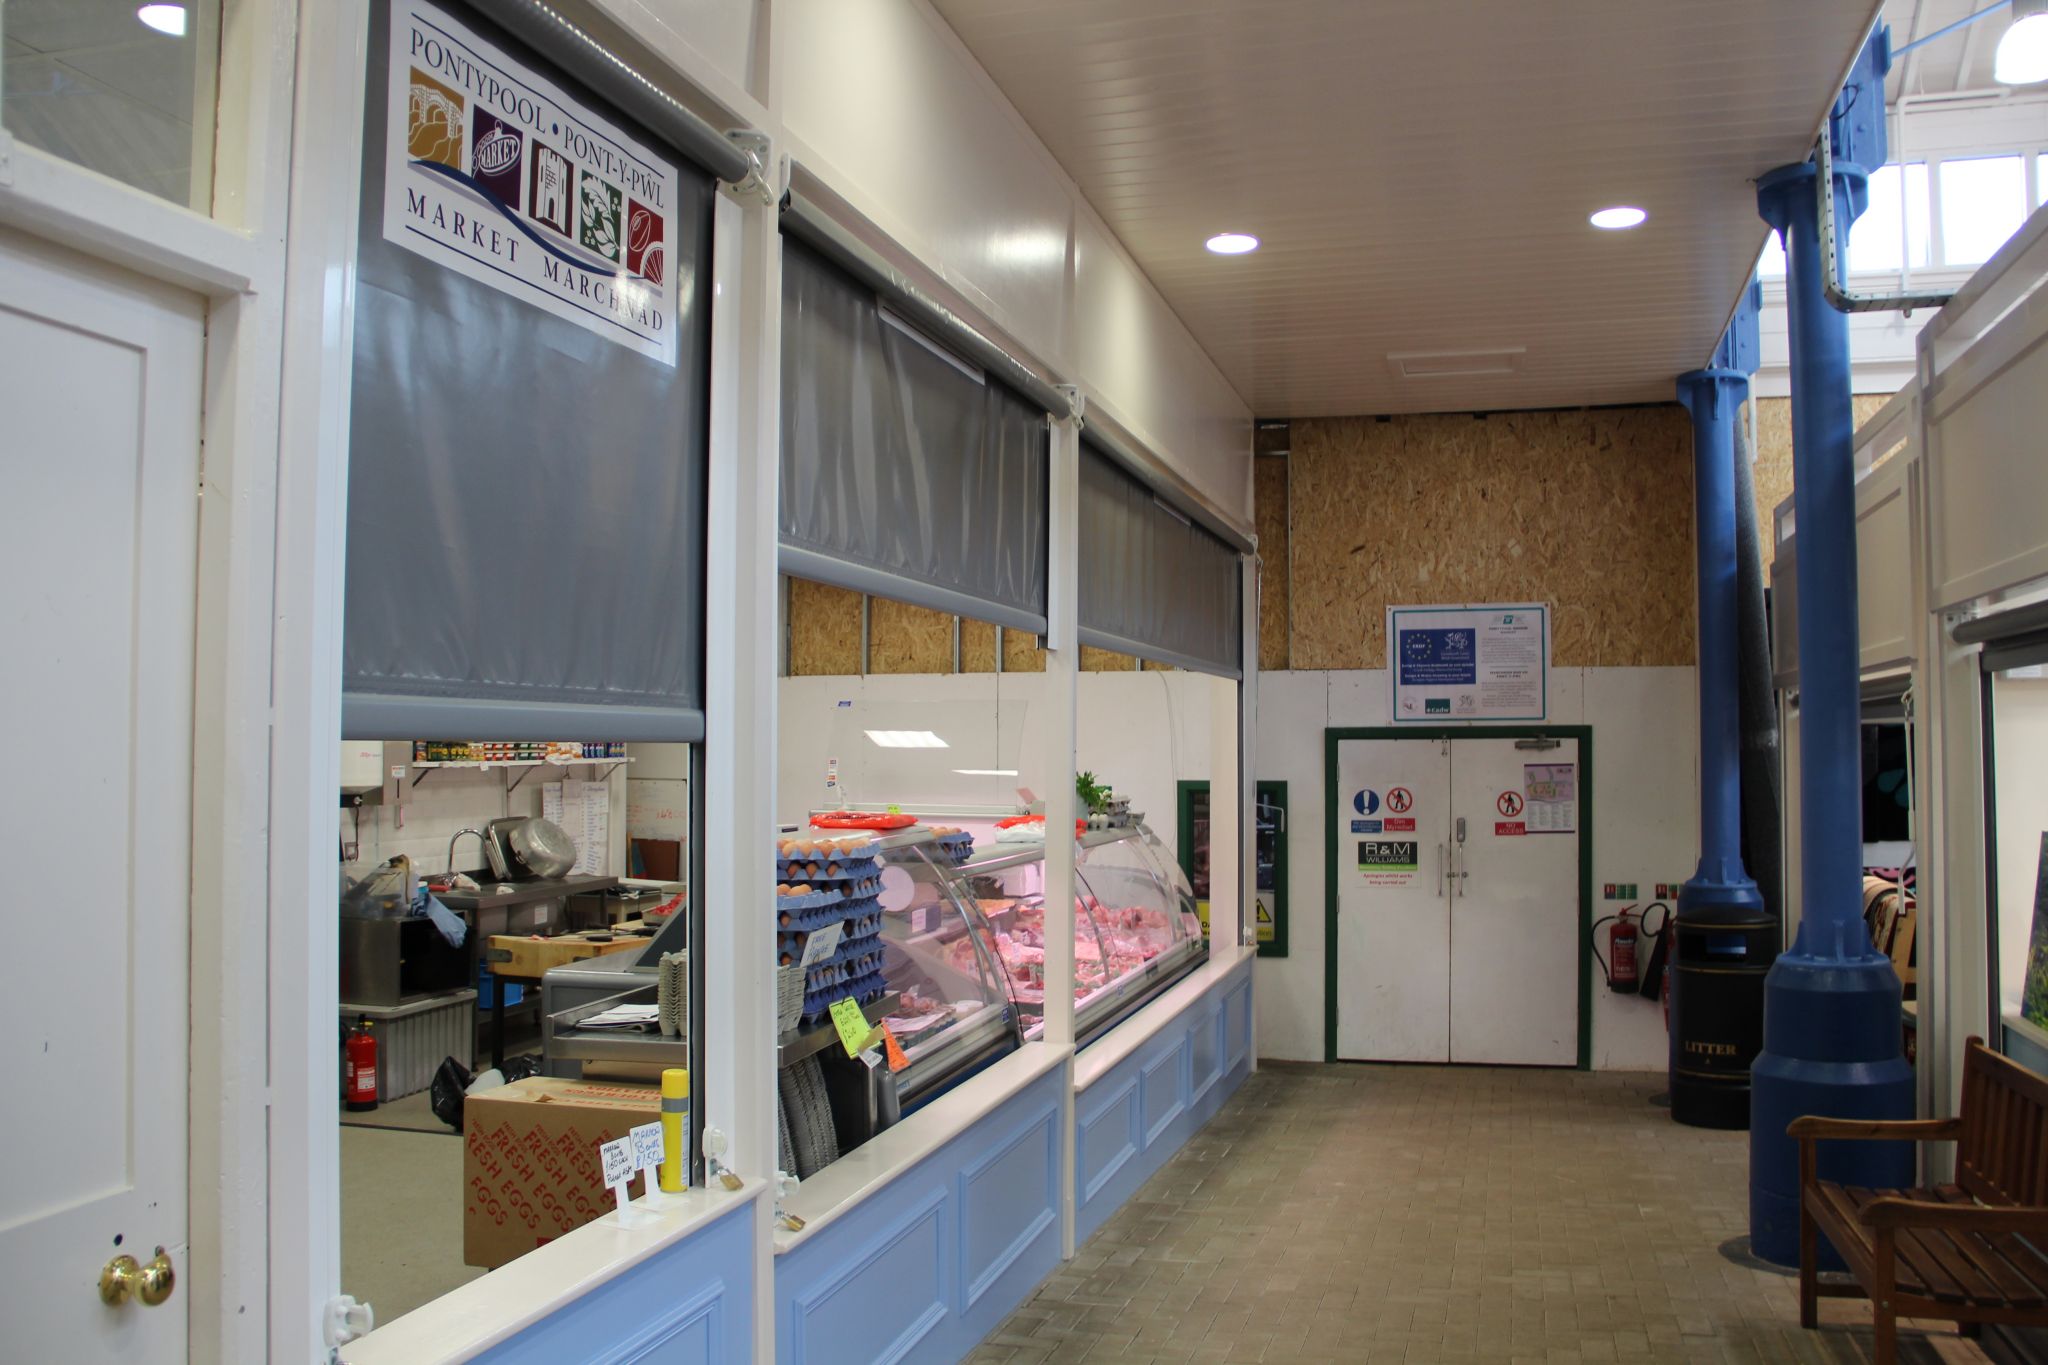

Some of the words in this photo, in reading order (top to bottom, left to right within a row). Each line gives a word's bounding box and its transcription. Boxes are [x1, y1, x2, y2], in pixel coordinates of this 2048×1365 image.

[410, 27, 546, 134] PONTYPOOL
[480, 138, 517, 168] MARKET
[407, 187, 519, 262] MARKET
[543, 255, 663, 331] MARCHNAD
[1366, 856, 1410, 864] WILLIAMS
[1685, 1040, 1736, 1056] LITTER
[468, 1131, 503, 1180] RESH
[501, 1179, 541, 1229] EGGS
[491, 1127, 535, 1183] FRESH
[533, 1182, 574, 1232] EGGS
[523, 1130, 568, 1187] FRESH
[556, 1133, 603, 1189] FRESH
